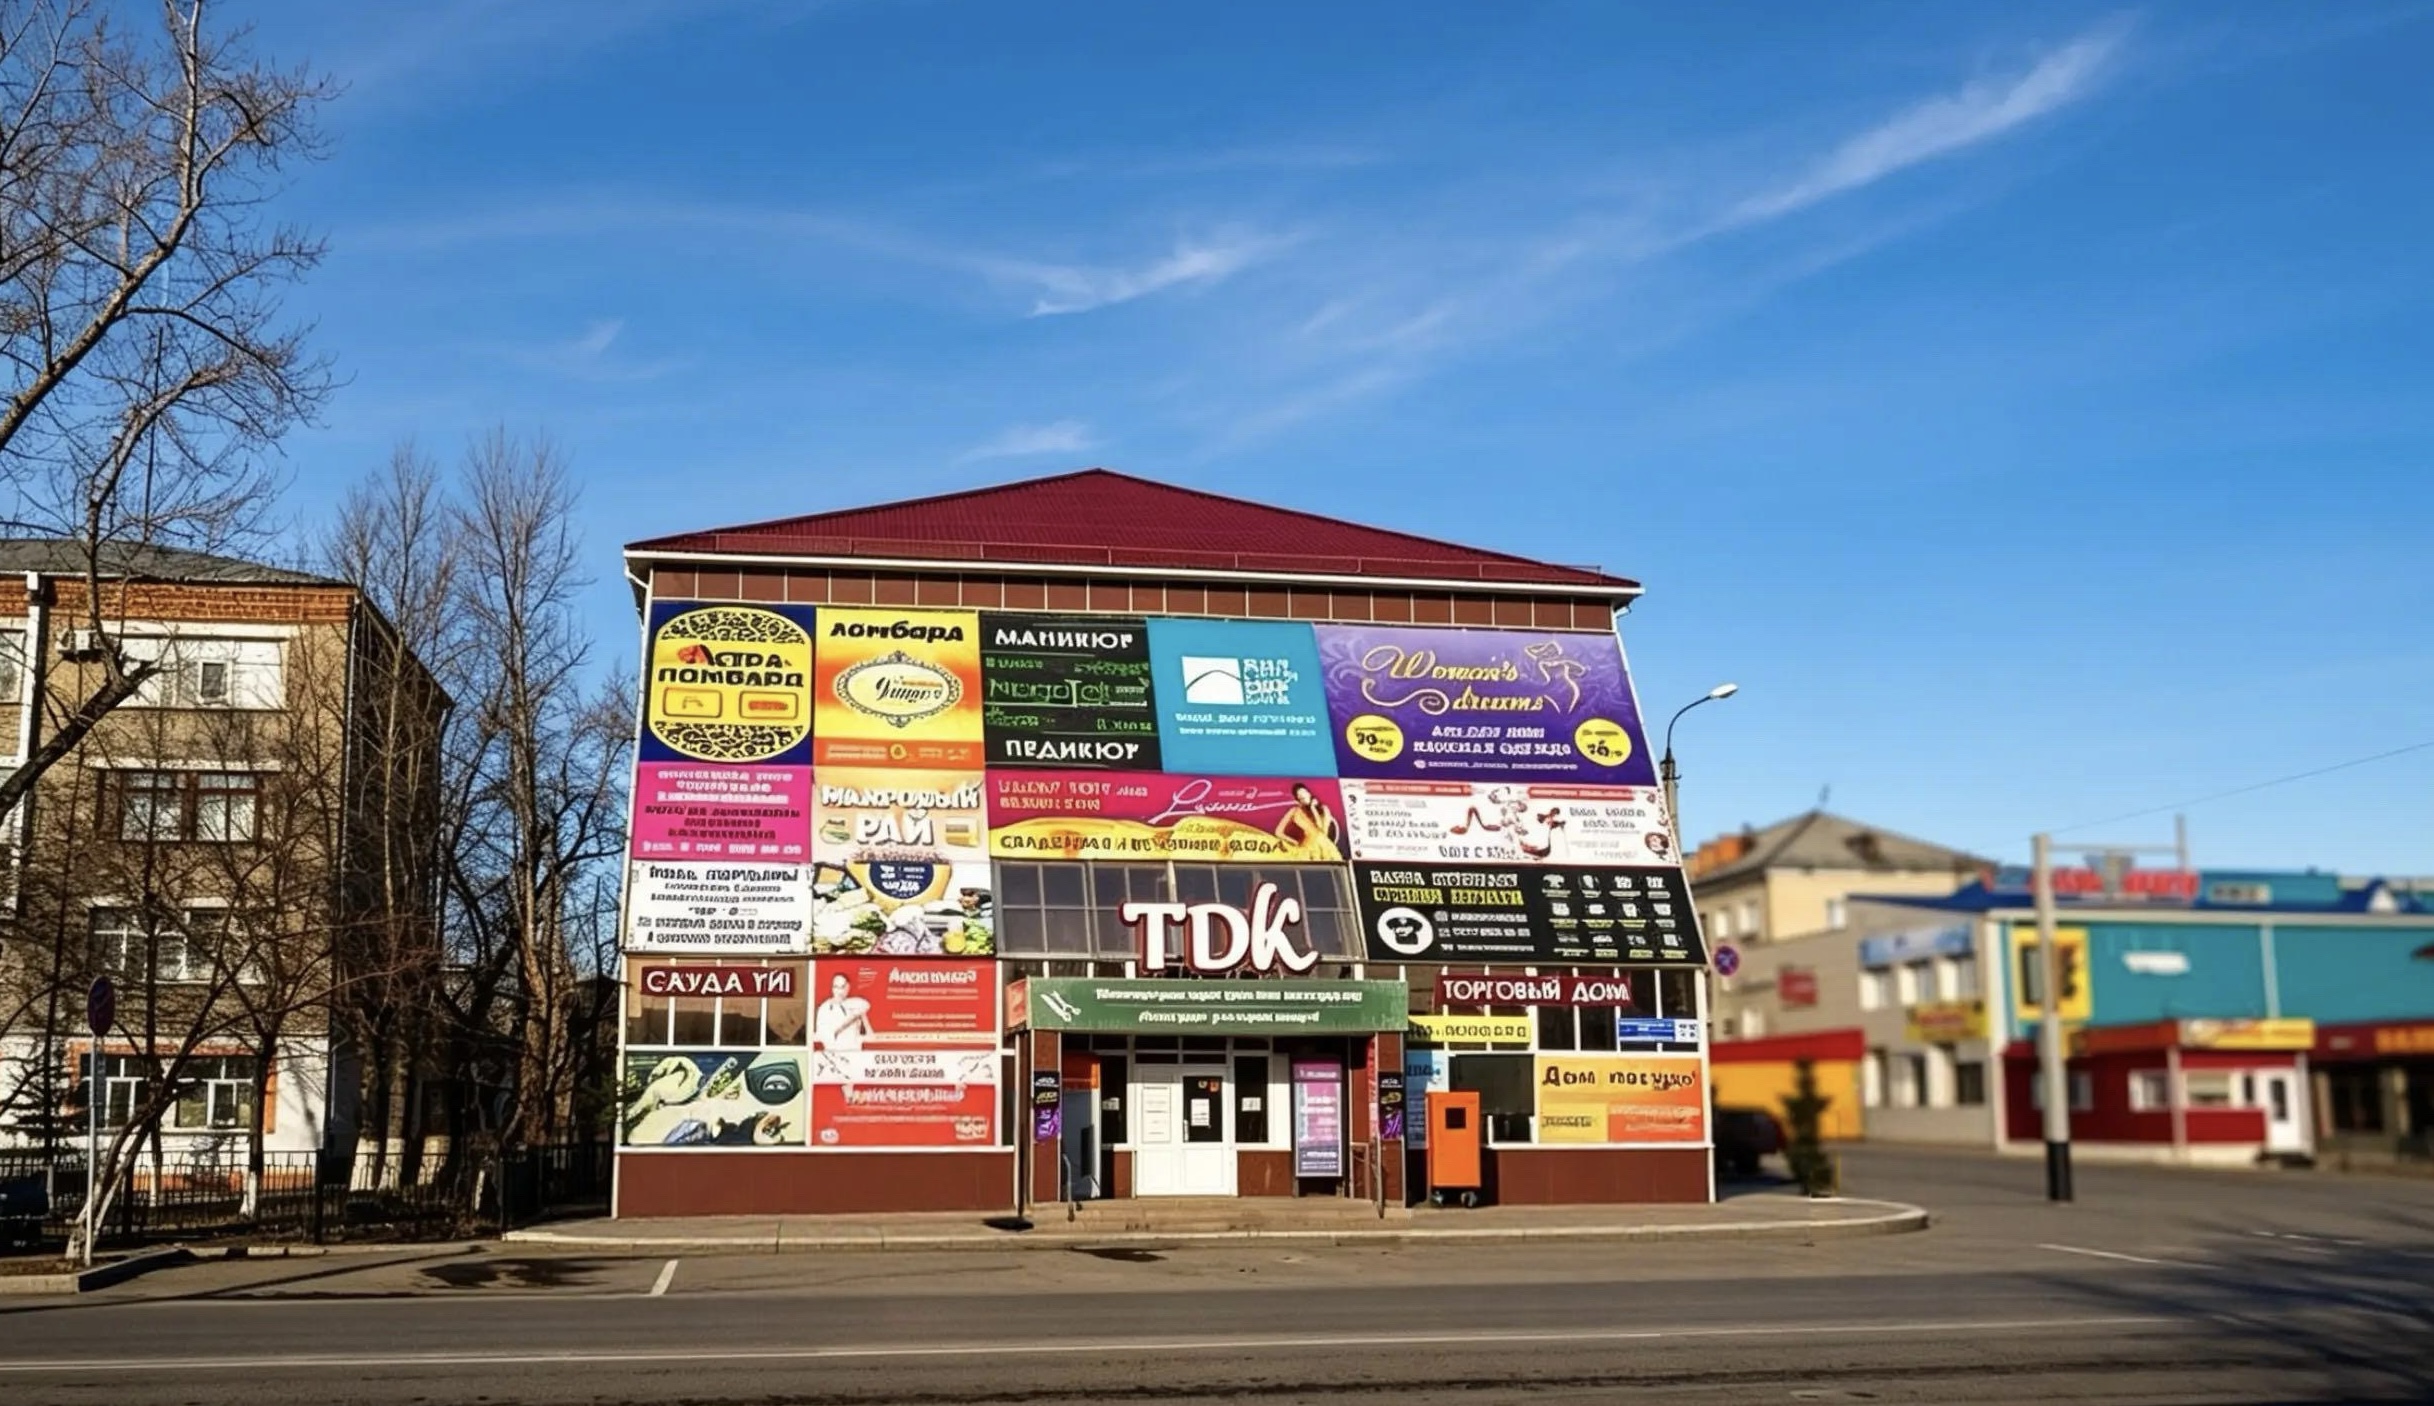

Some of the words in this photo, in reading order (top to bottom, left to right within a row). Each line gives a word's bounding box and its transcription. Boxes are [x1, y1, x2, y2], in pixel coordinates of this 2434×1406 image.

[1122, 883, 1319, 971] TDK
[646, 970, 744, 995] САУДА
[1443, 977, 1561, 1001] ТОРГОВЫЙ
[1571, 982, 1630, 1002] ДОМ
